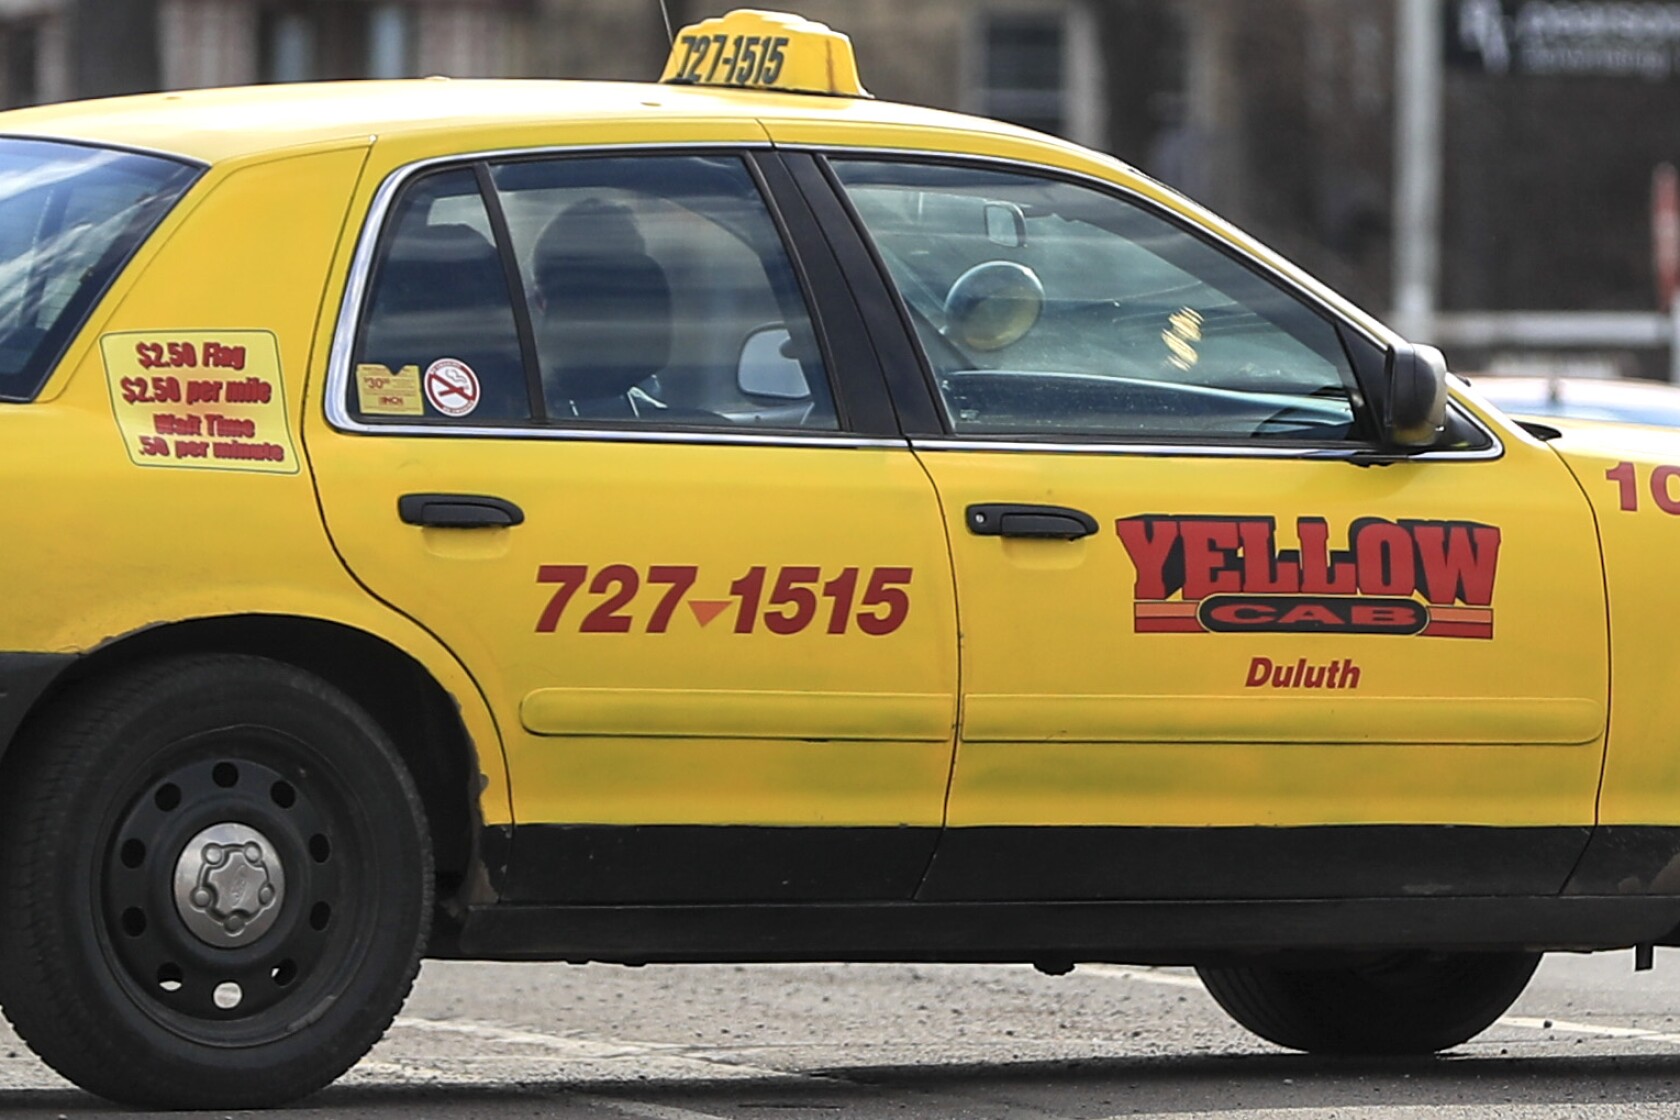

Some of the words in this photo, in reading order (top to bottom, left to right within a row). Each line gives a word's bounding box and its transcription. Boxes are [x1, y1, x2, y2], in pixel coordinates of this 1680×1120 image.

[677, 34, 790, 85] 727-1515
[136, 341, 198, 370] $2.50
[202, 341, 247, 371] Flag
[120, 376, 182, 405] $2.50
[186, 380, 224, 406] per
[224, 376, 273, 404] mile
[153, 413, 202, 436] Wait
[204, 414, 256, 439] Time
[138, 436, 171, 456] .50
[174, 439, 210, 459] per
[212, 440, 285, 463] minute
[1115, 513, 1502, 607] YELLOW
[1209, 604, 1418, 627] CAB
[1245, 656, 1361, 689] Duluth
